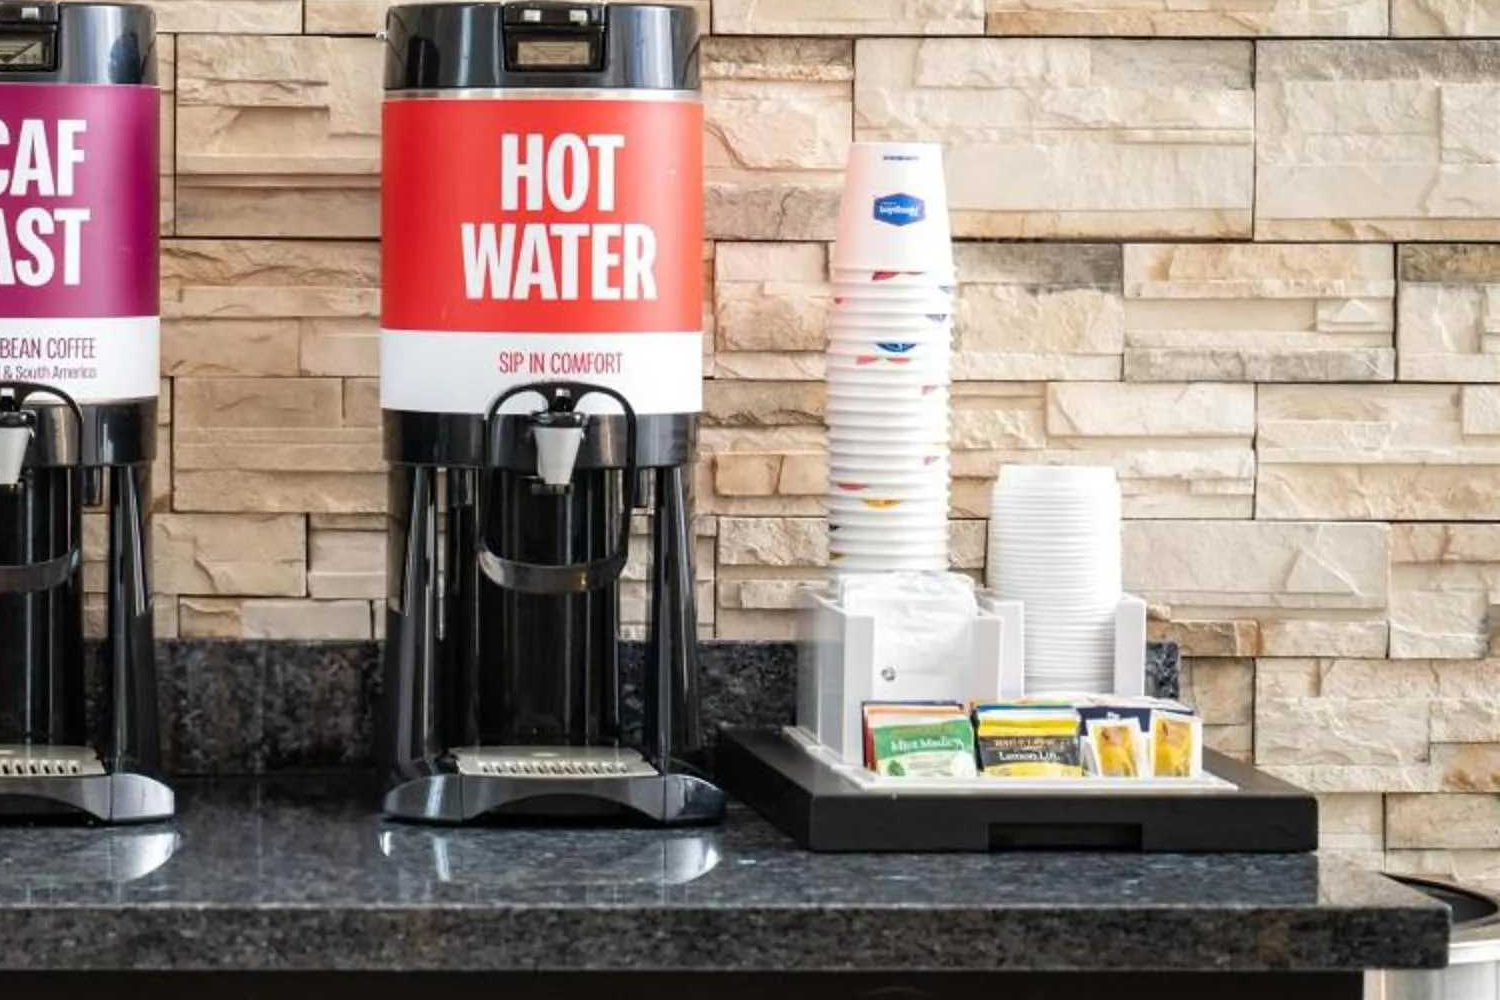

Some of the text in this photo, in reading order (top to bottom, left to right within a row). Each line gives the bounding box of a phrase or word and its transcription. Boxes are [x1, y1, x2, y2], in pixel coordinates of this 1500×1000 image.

[501, 133, 626, 212] HOT
[461, 223, 658, 301] WATER
[0, 337, 41, 358] BEAN
[46, 337, 97, 358] COFFEE
[3, 365, 13, 380] &
[15, 365, 50, 380] South
[52, 365, 97, 379] America
[499, 352, 623, 374] SIP IN COMFORT
